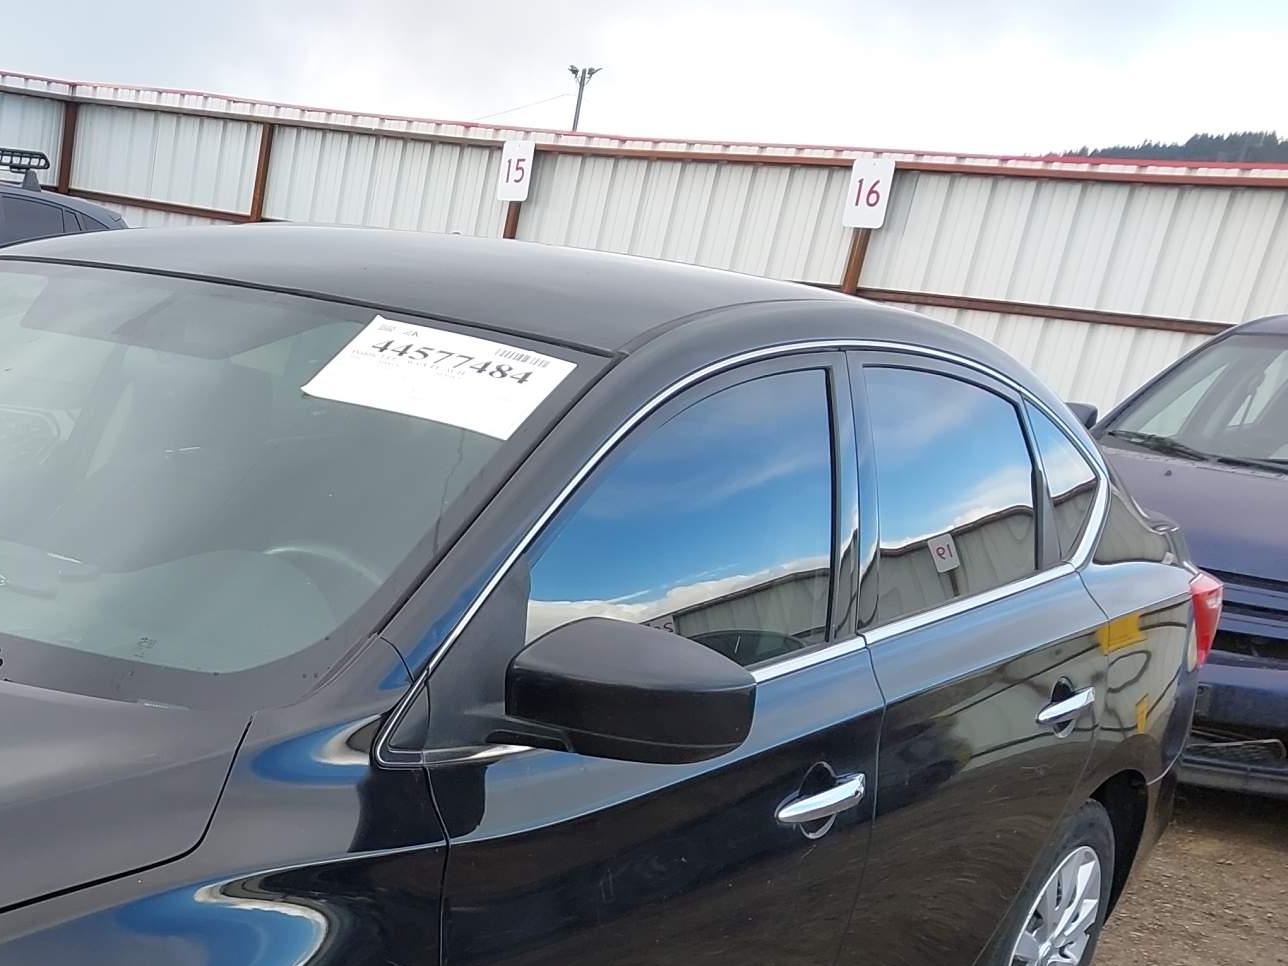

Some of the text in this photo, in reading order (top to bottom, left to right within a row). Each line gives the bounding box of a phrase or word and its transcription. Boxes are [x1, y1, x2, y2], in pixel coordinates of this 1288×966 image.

[505, 158, 526, 183] 15
[855, 178, 880, 207] 16
[371, 339, 534, 384] 44577484
